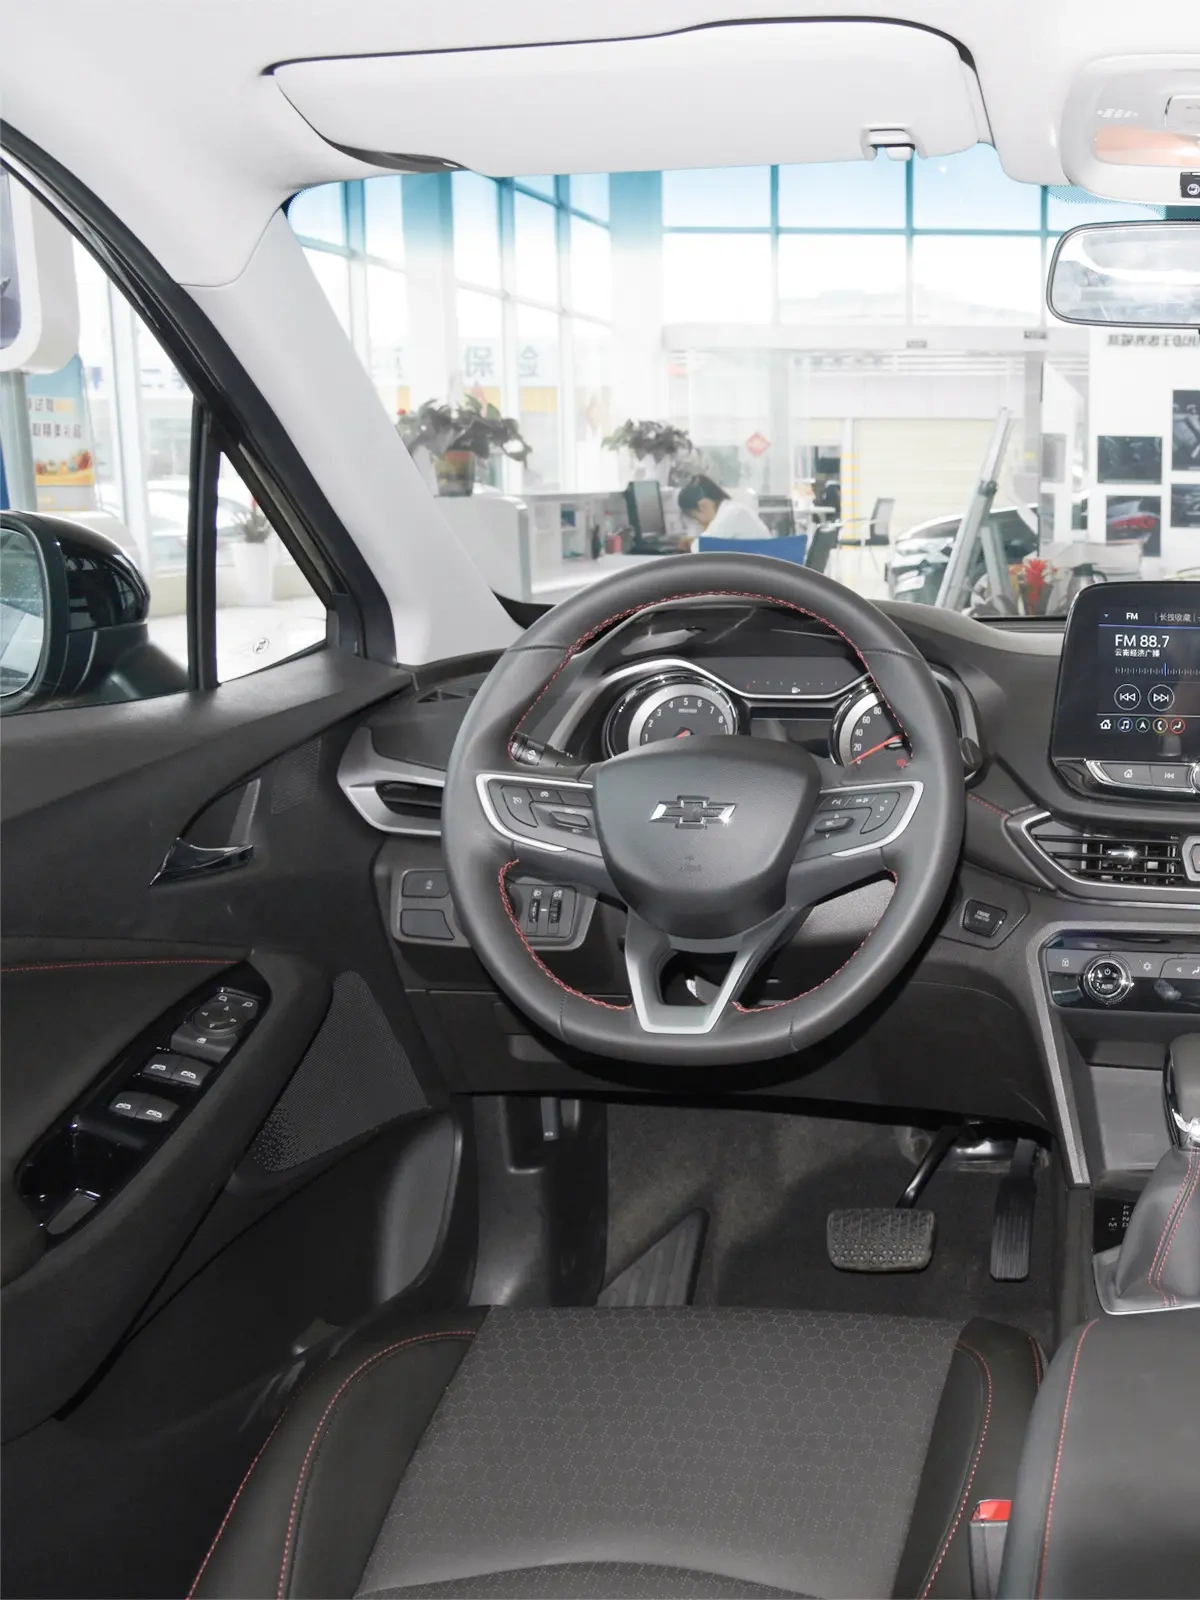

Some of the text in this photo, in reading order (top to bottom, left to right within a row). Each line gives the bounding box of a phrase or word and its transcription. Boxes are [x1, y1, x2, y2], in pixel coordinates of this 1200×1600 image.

[1126, 612, 1139, 620] FM
[1115, 634, 1170, 648] FM 88.7
[668, 700, 674, 708] 4
[683, 697, 689, 705] 5
[697, 699, 703, 708] 6
[656, 708, 662, 717] 3
[710, 706, 715, 714] 7
[873, 706, 882, 715] 80
[648, 719, 654, 728] 2
[718, 715, 724, 724] 8
[862, 715, 871, 724] 60
[644, 733, 649, 741] 1
[854, 728, 864, 737] 40
[853, 743, 862, 752] 20
